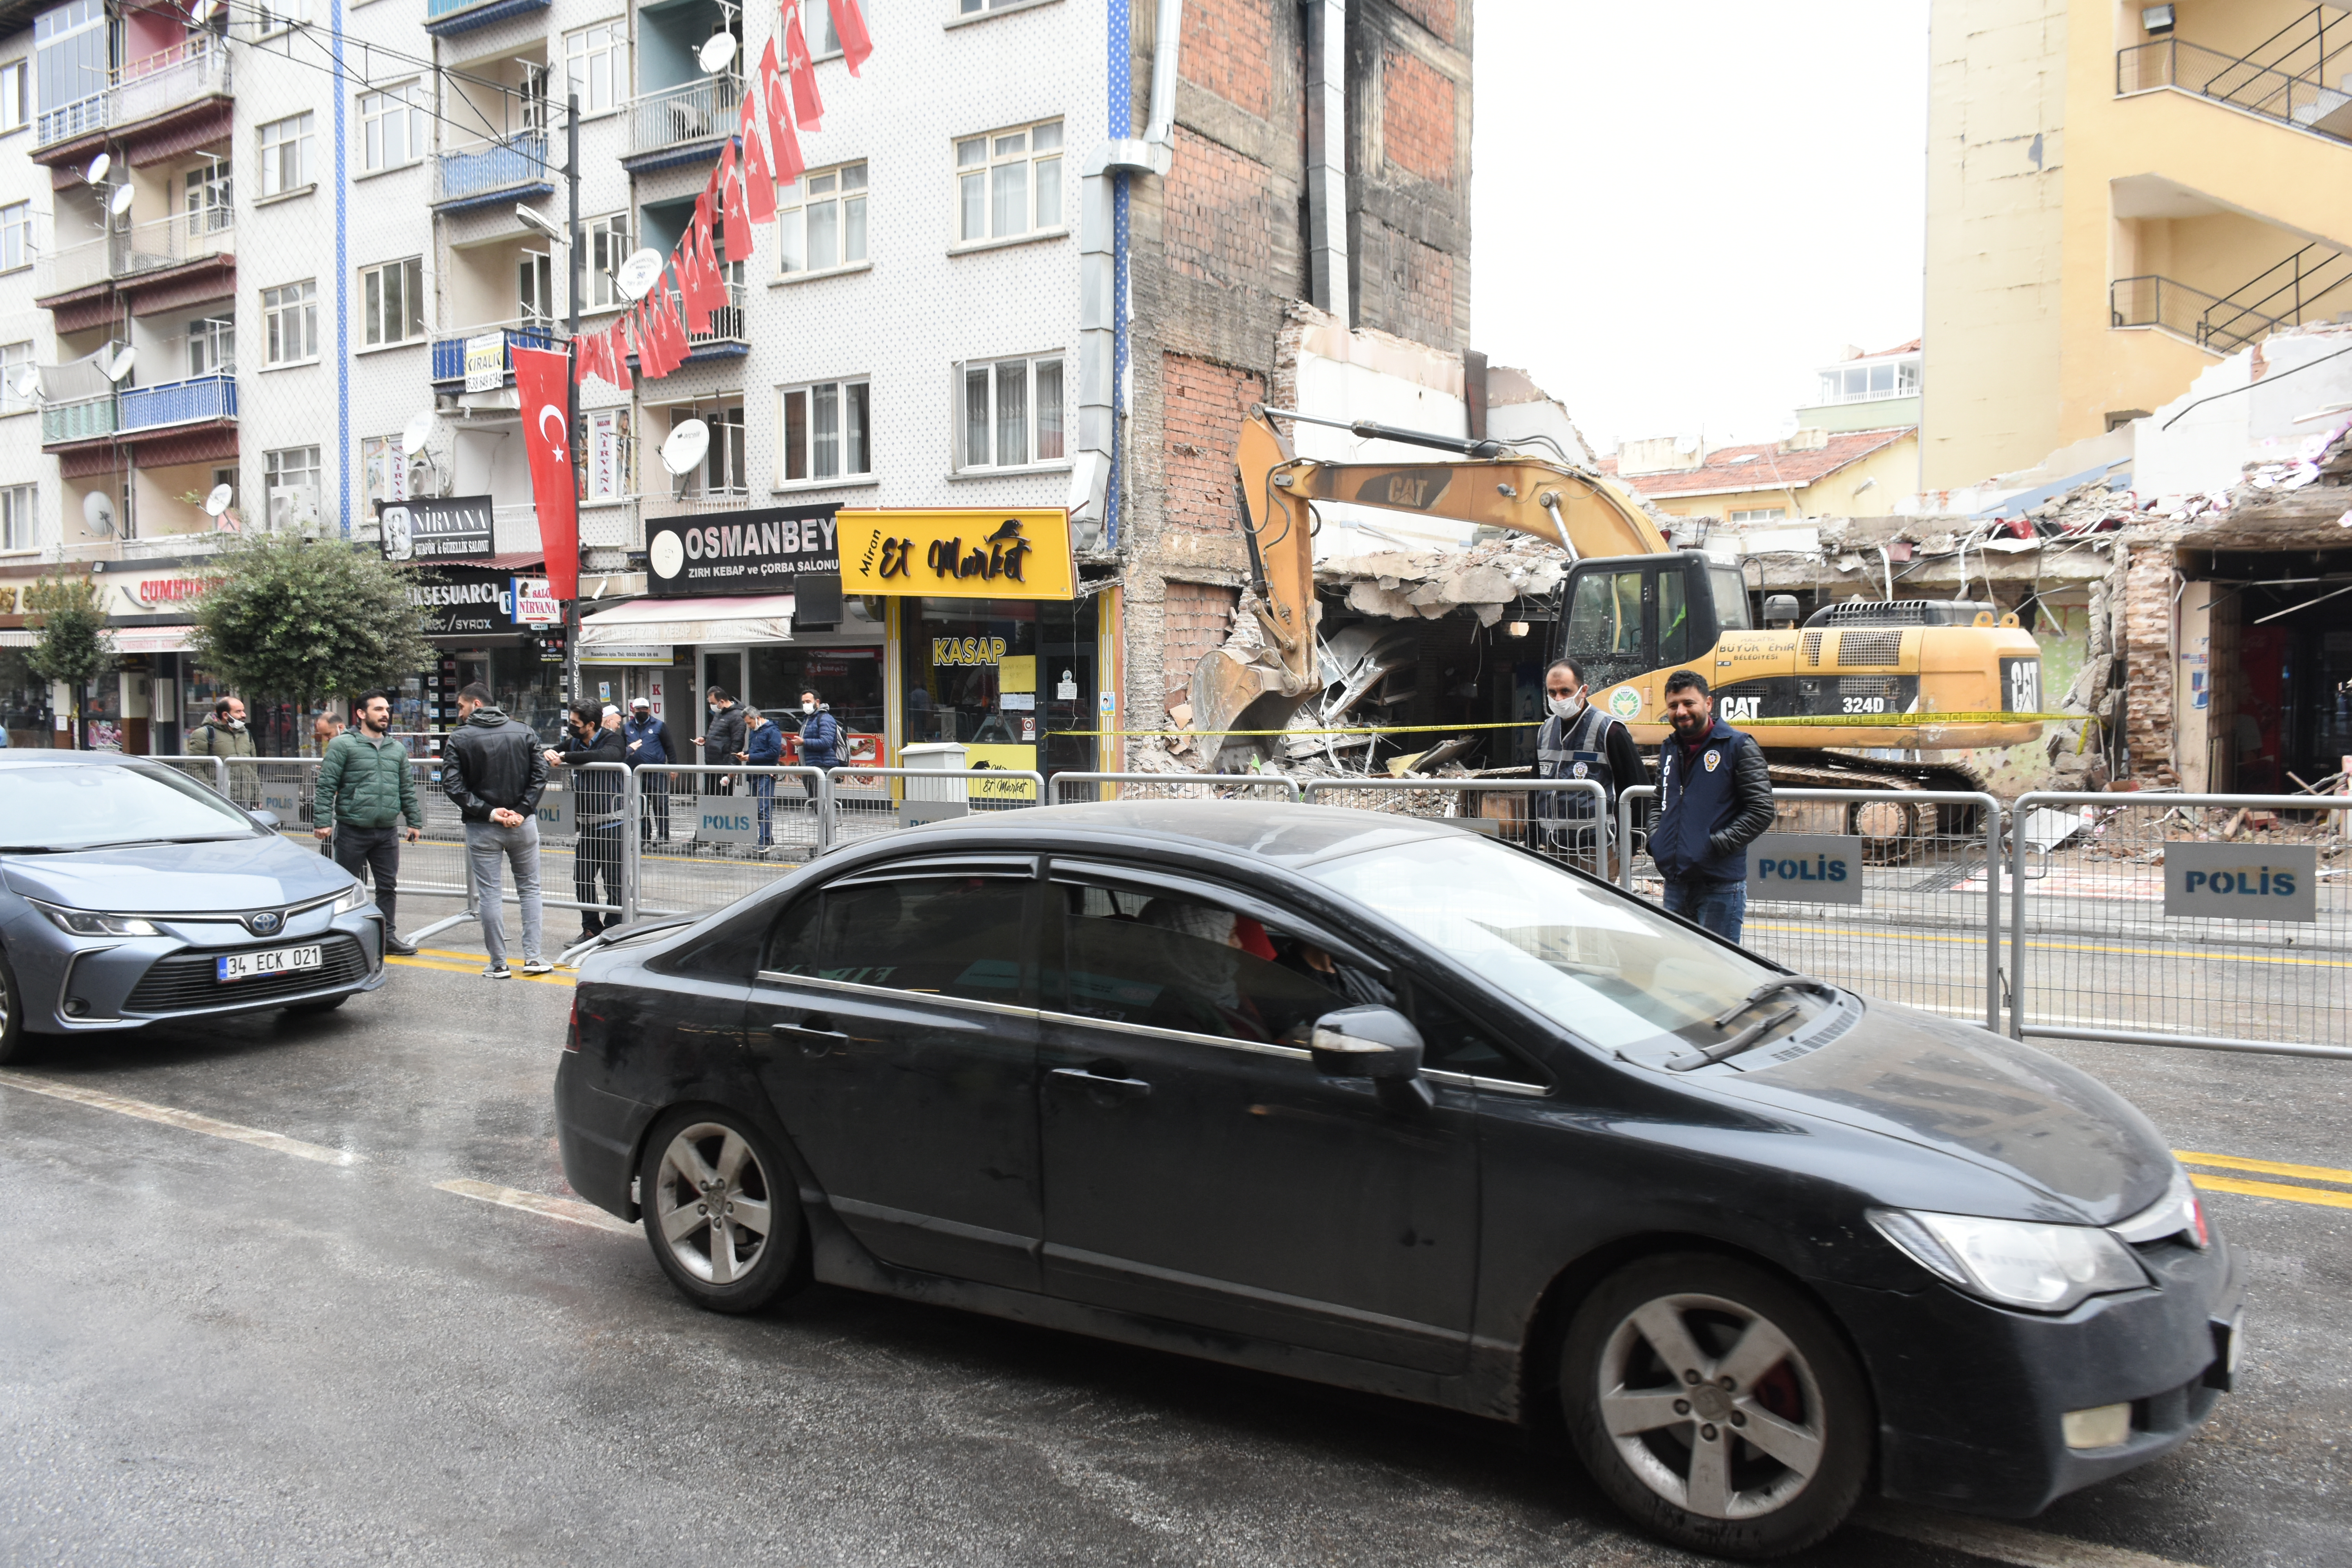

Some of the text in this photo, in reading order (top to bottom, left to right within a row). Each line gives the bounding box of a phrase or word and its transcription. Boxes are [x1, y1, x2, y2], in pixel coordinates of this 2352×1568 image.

[468, 352, 501, 372] KİRALIK
[600, 432, 610, 493] NİRVANA
[394, 456, 403, 502] NİRVAN
[1388, 476, 1428, 506] CAT
[414, 506, 487, 533] NİRVANA
[443, 538, 468, 554] GÜZELLİK
[468, 540, 489, 553] SALONU
[686, 517, 837, 560] OSMANBEY
[858, 528, 881, 577] Miran
[879, 536, 1032, 582] Et Market
[688, 567, 710, 578] ZIRH
[713, 565, 745, 577] KEBAP
[761, 563, 795, 577] ÇORBA
[797, 559, 838, 572] SALONU
[519, 600, 557, 614] NİRVANA
[456, 619, 493, 630] SYROX
[640, 626, 660, 639] ZIRH
[664, 625, 691, 639] KEBAP
[695, 628, 701, 638] &
[706, 624, 733, 641] ÇORBA
[736, 622, 771, 636] SALONU
[933, 637, 1006, 666] KASAP
[1719, 643, 1759, 652] BÜYÜK
[2011, 662, 2038, 713] CAT
[1720, 697, 1760, 720] CAT
[1843, 697, 1884, 713] 324D
[983, 780, 1028, 794] Et Market
[1662, 755, 1672, 811] POLİS
[1759, 854, 1847, 881] POLİS
[2185, 866, 2296, 897] POLİS
[229, 947, 318, 975] 34 ECK 021
